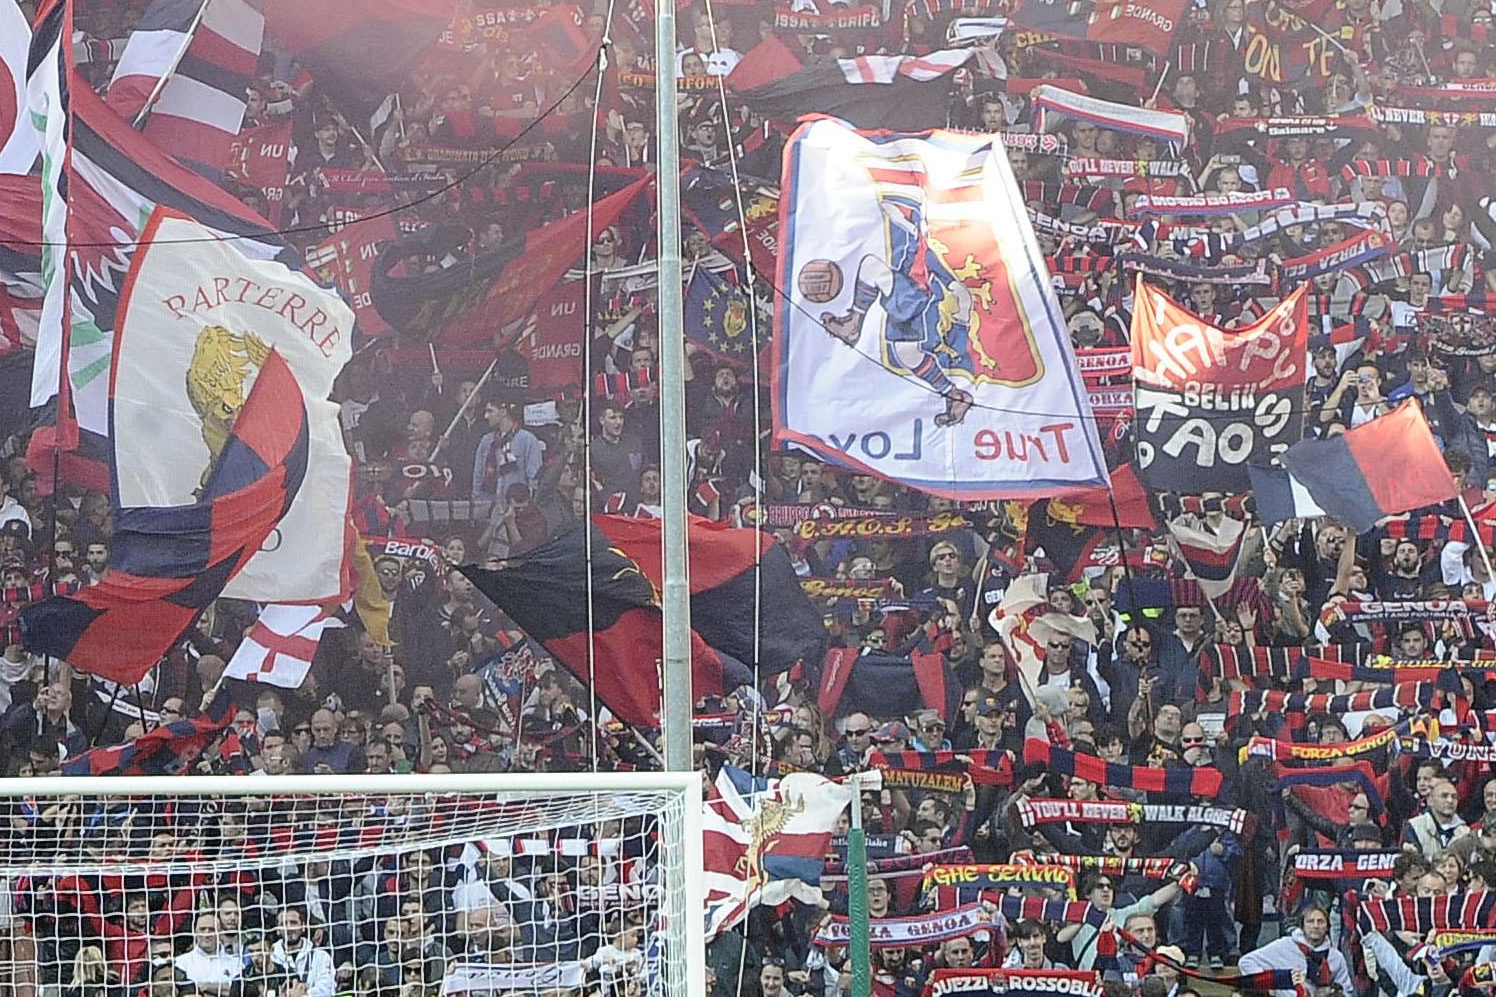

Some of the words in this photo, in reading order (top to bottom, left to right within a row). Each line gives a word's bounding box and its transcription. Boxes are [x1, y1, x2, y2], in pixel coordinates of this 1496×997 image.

[1385, 107, 1426, 124] NEVER
[1099, 159, 1135, 175] NEVER
[1149, 160, 1178, 176] WALK
[162, 277, 341, 359] PARTERRE
[1088, 393, 1134, 408] ORZA
[1359, 600, 1468, 614] GENOA
[1290, 745, 1343, 759] FORZA
[1345, 732, 1398, 755] GENOA
[884, 769, 964, 793] MATUZALEM
[1034, 802, 1080, 822] YOU'LL
[1083, 803, 1128, 821] NEVER
[1143, 804, 1185, 822] WALK
[1186, 804, 1232, 827] ALONE
[933, 864, 980, 886] GHE
[907, 913, 973, 936] GENOA
[1009, 976, 1104, 997] ROSSOBLU
